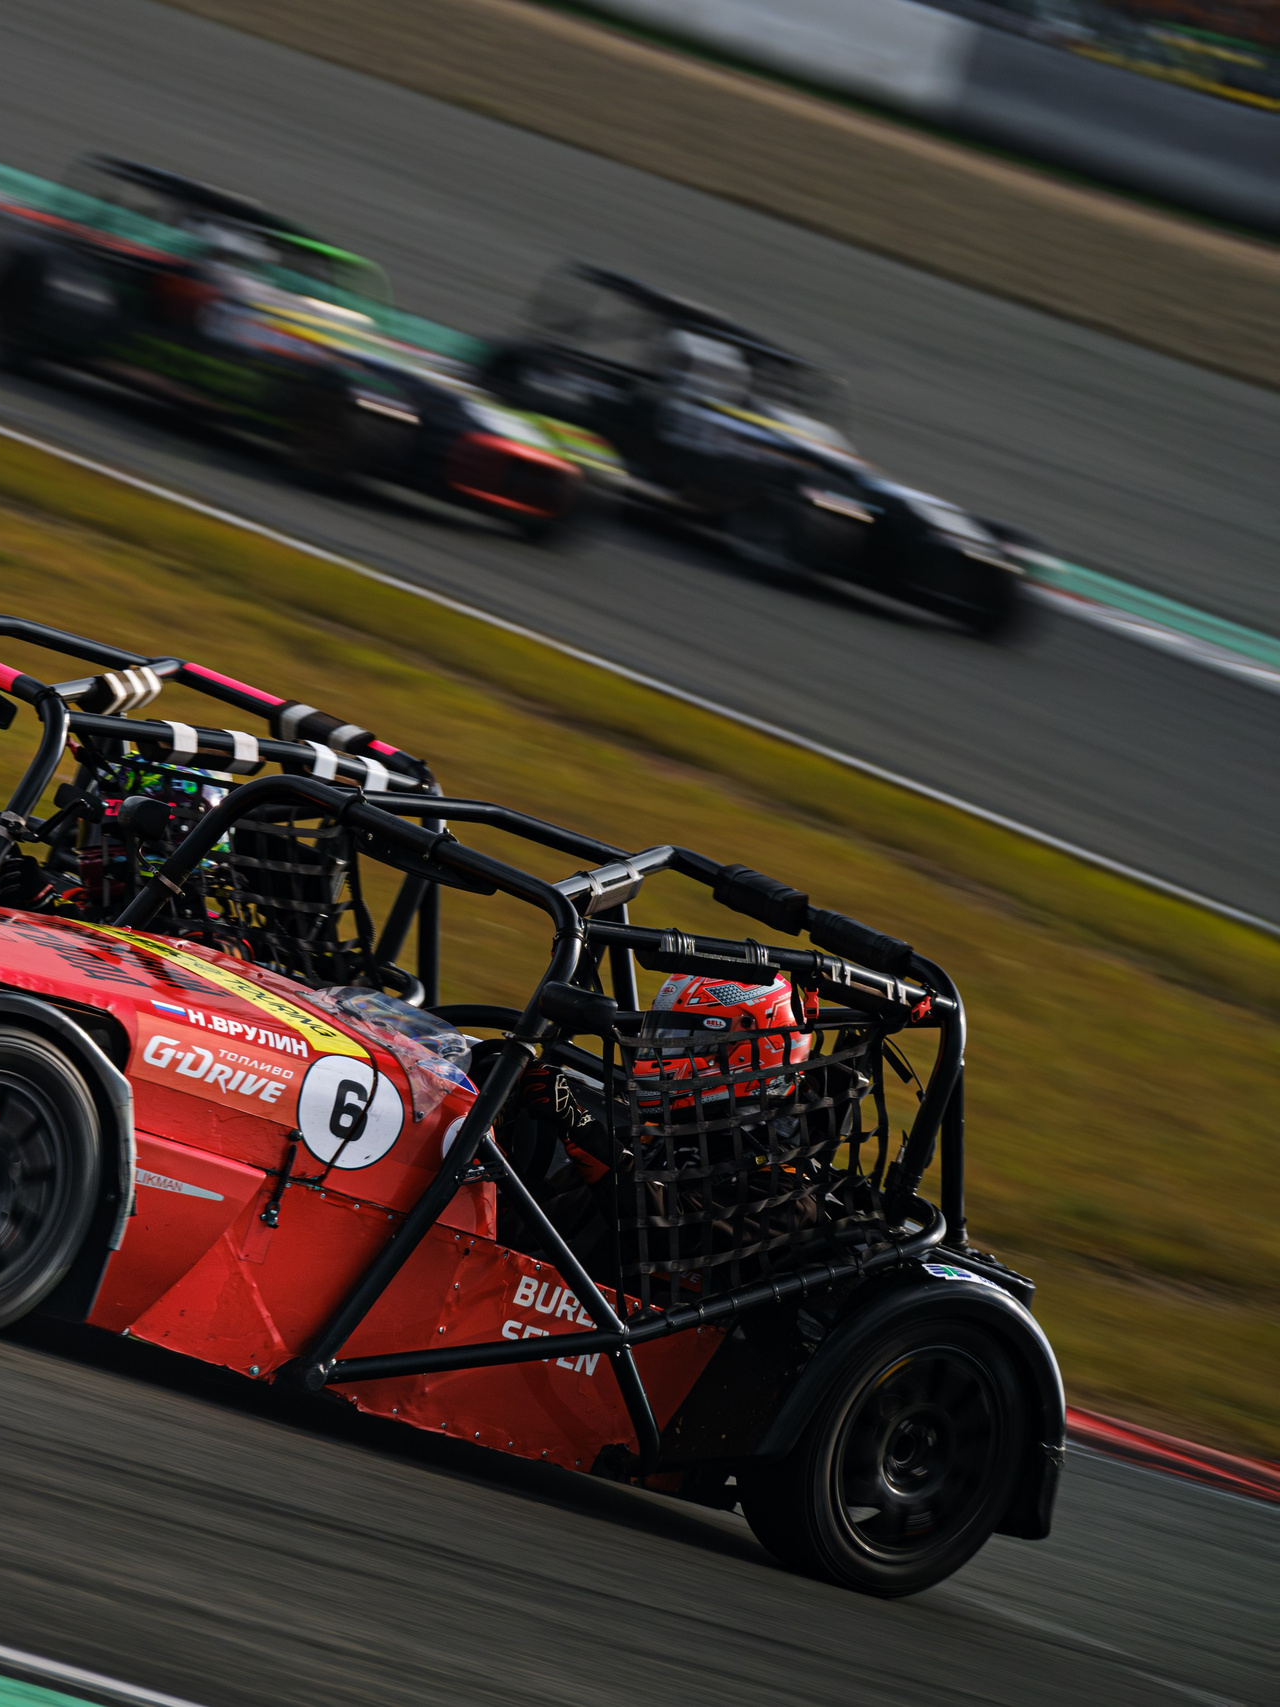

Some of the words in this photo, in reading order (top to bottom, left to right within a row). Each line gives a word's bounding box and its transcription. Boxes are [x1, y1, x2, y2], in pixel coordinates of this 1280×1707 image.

[224, 976, 337, 1038] TOURING
[218, 1048, 295, 1080] ТОПЛИВО
[329, 1078, 369, 1142] 6
